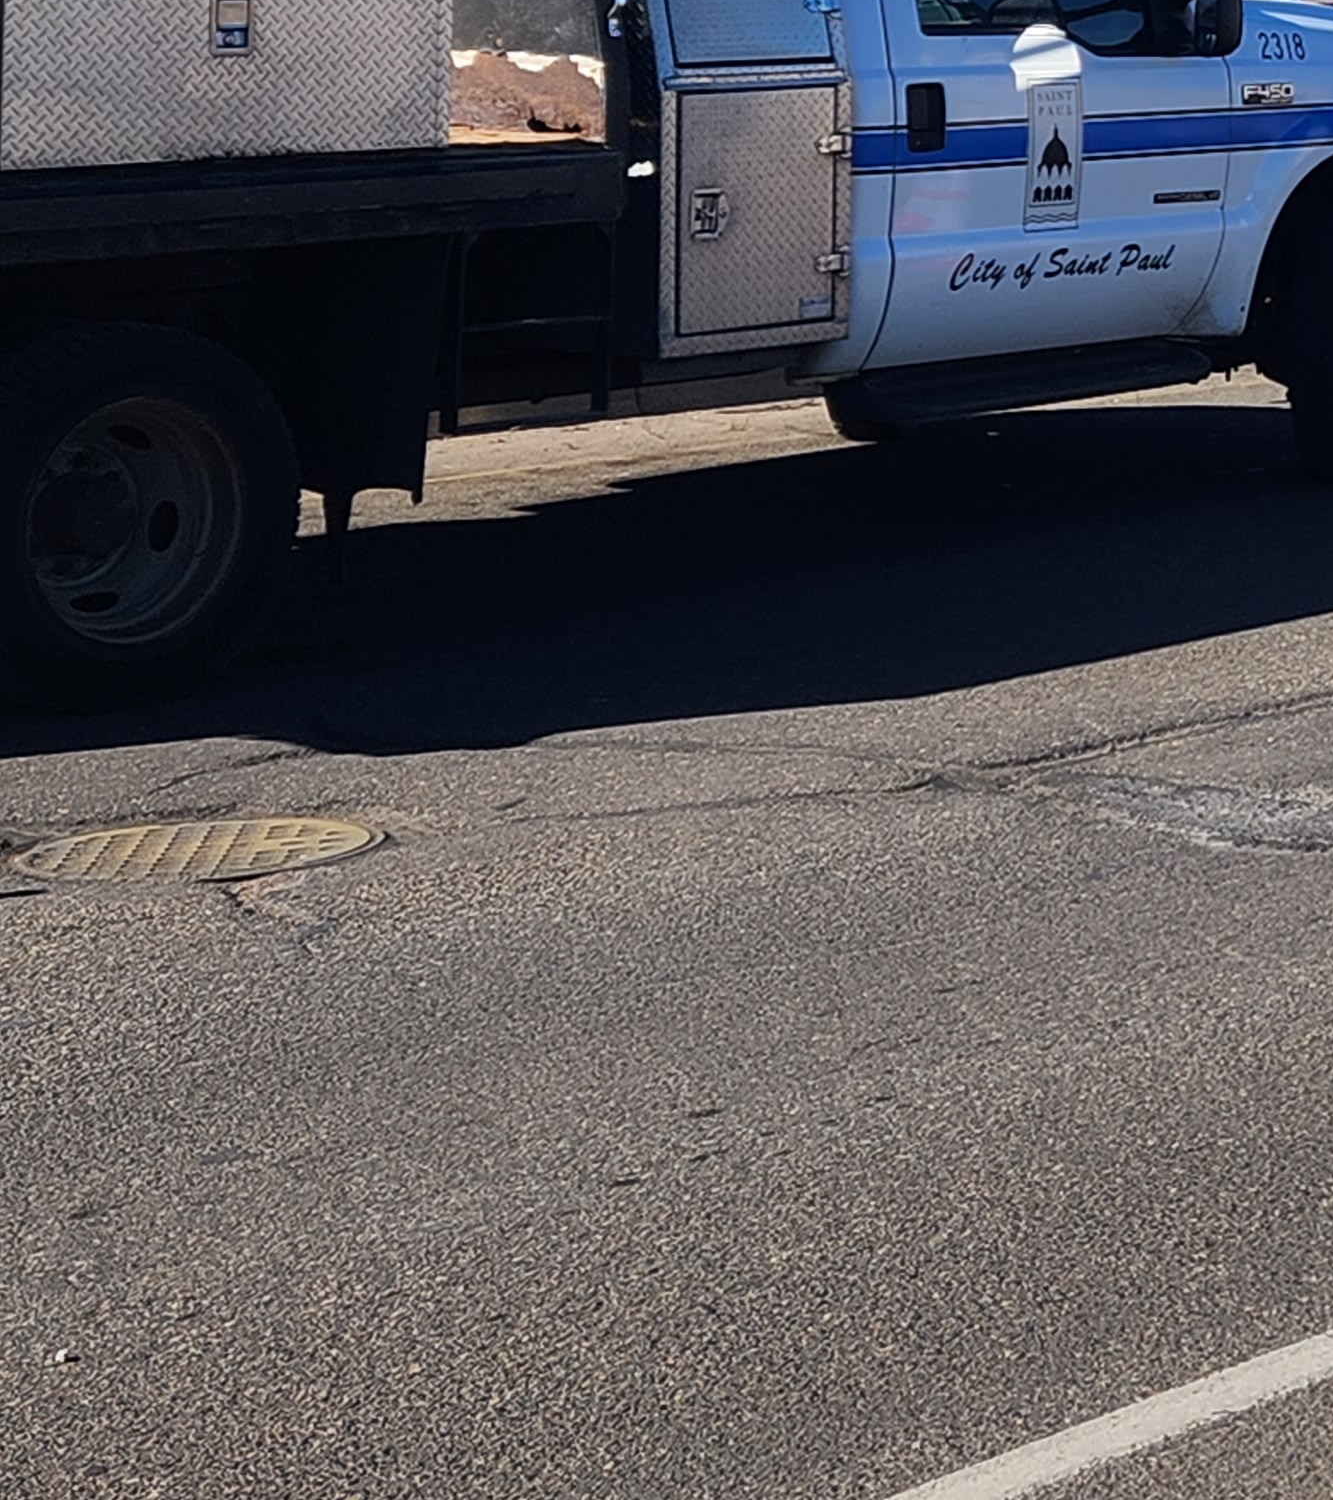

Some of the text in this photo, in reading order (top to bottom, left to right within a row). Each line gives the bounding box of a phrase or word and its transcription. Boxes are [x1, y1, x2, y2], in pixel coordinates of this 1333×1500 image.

[1257, 32, 1306, 61] 2318
[1036, 90, 1073, 102] SAINT
[1243, 83, 1295, 100] F450
[1037, 105, 1073, 116] PAUL
[949, 243, 1176, 292] City of Saint Paul
